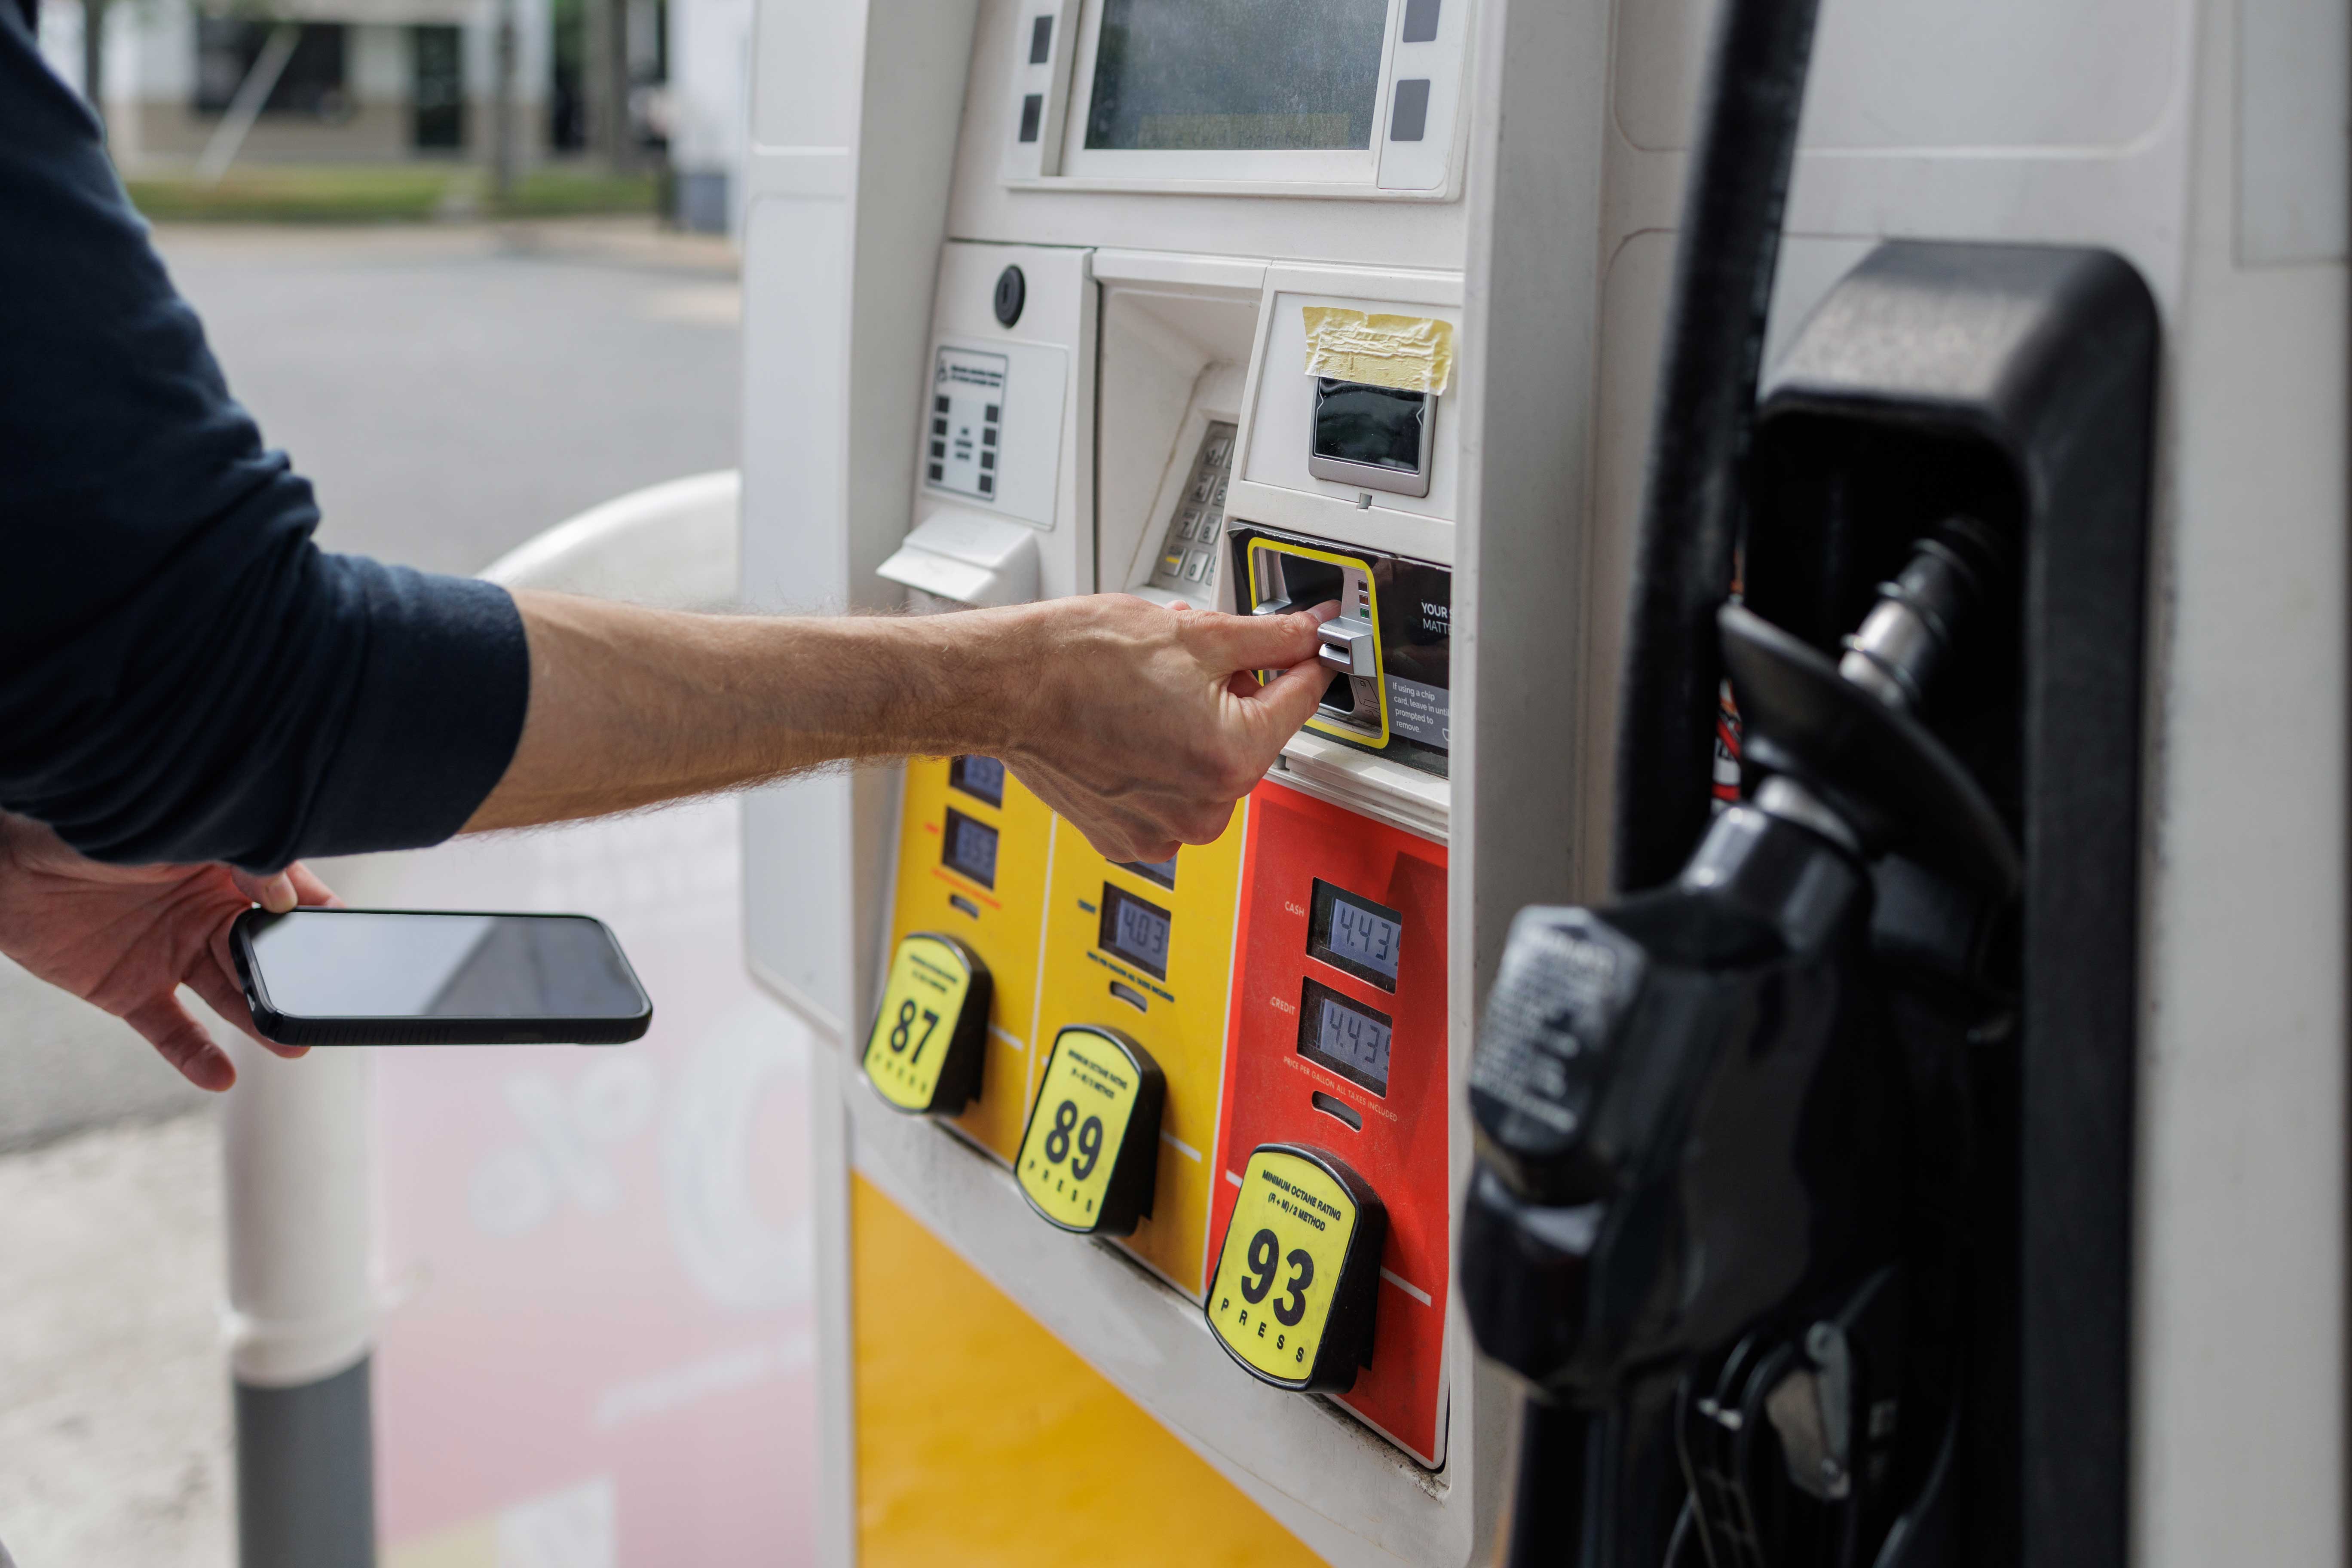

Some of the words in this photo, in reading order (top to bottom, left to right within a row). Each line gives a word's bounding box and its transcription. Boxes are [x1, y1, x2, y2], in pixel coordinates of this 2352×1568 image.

[1421, 602, 1448, 618] YOUR
[1393, 682, 1397, 690] If
[1398, 685, 1415, 697] using
[1421, 690, 1435, 701] chip
[1394, 696, 1409, 707] card,
[1410, 698, 1427, 710] leave
[1428, 703, 1434, 713] in
[1395, 708, 1425, 723] prompted
[1427, 716, 1434, 724] to
[1396, 720, 1421, 733] remove.
[1285, 901, 1305, 917] CASH
[1271, 996, 1295, 1015] CREDIT
[891, 998, 940, 1065] 87
[1283, 1056, 1299, 1070] PRICE
[1299, 1064, 1310, 1075] PER
[1312, 1071, 1335, 1089] GALLON
[1336, 1084, 1346, 1095] ALL
[1348, 1089, 1366, 1105] TAXES
[1367, 1100, 1398, 1122] INCLUDED
[1045, 1099, 1103, 1181] 89
[1262, 1169, 1291, 1192] MINIMUM
[1291, 1186, 1317, 1207] OCTANE
[1317, 1200, 1341, 1221] RATING
[1298, 1209, 1325, 1231] METHOD
[1241, 1228, 1314, 1326] 93
